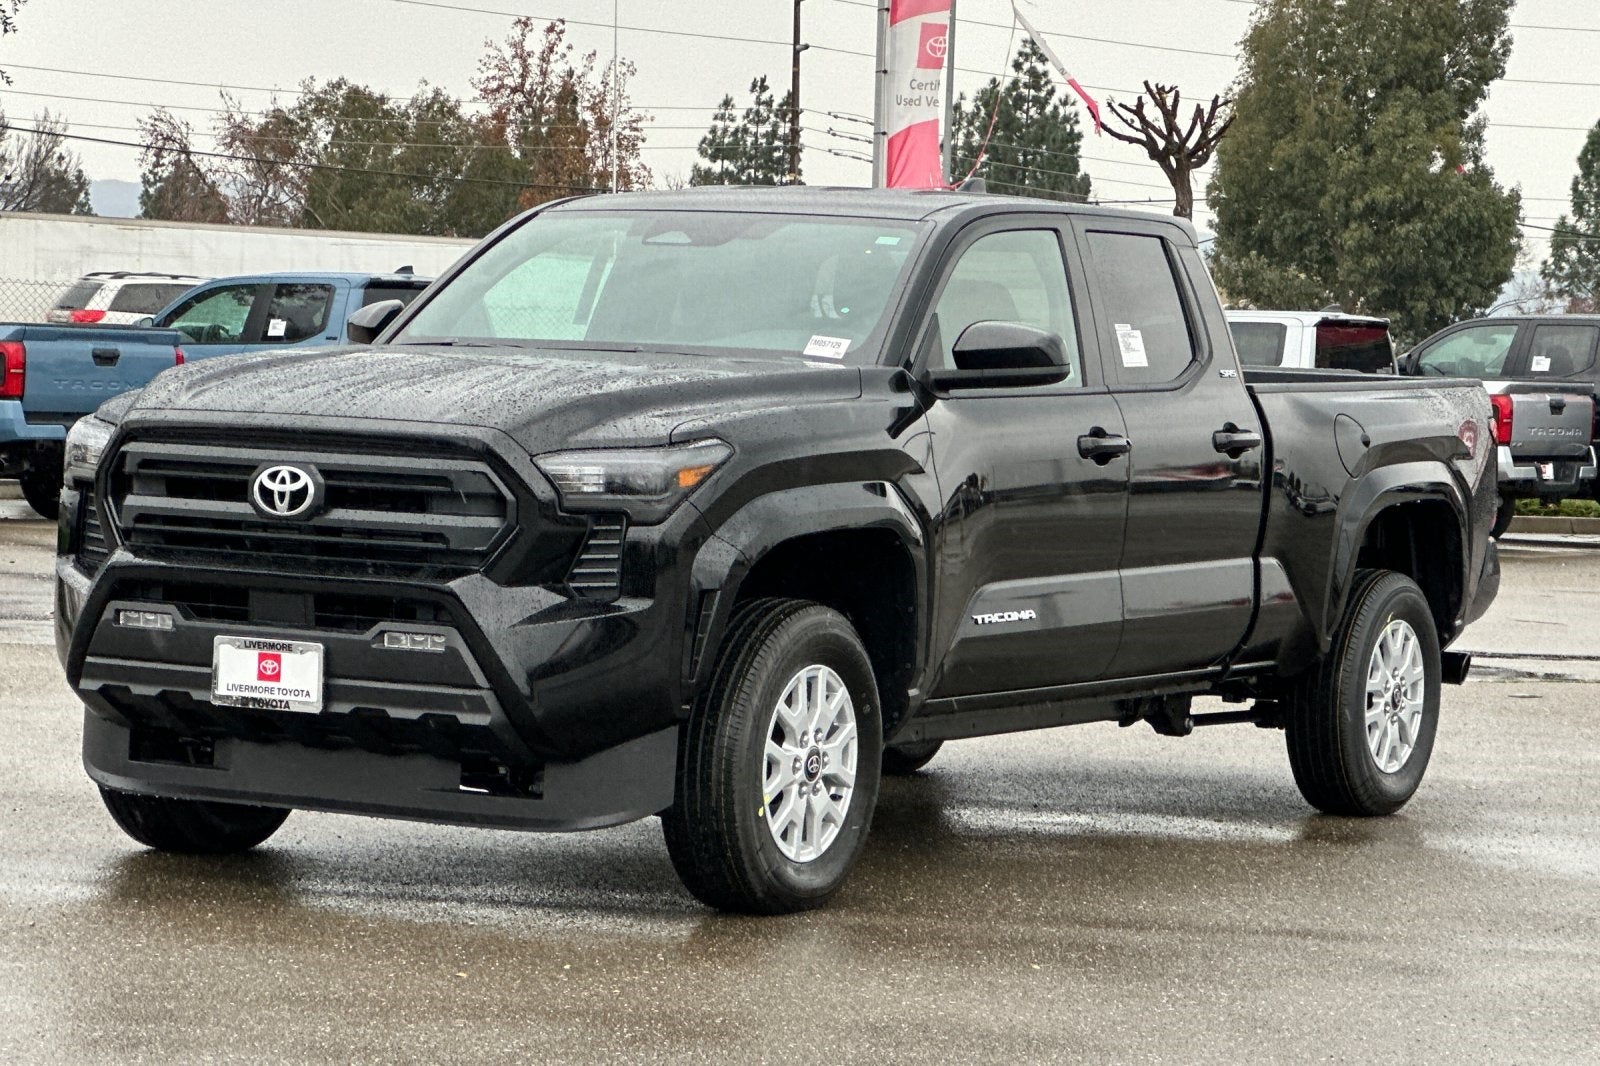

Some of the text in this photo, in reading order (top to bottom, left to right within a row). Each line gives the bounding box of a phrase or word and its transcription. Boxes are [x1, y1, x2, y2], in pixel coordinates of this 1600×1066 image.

[896, 94, 922, 107] Used
[1528, 427, 1583, 437] TACOMA
[971, 609, 1037, 625] TACOMA
[244, 640, 293, 652] LIVERMORE
[226, 683, 311, 699] LIVERMORE TOYOTA
[250, 697, 291, 711] TOYOTA
